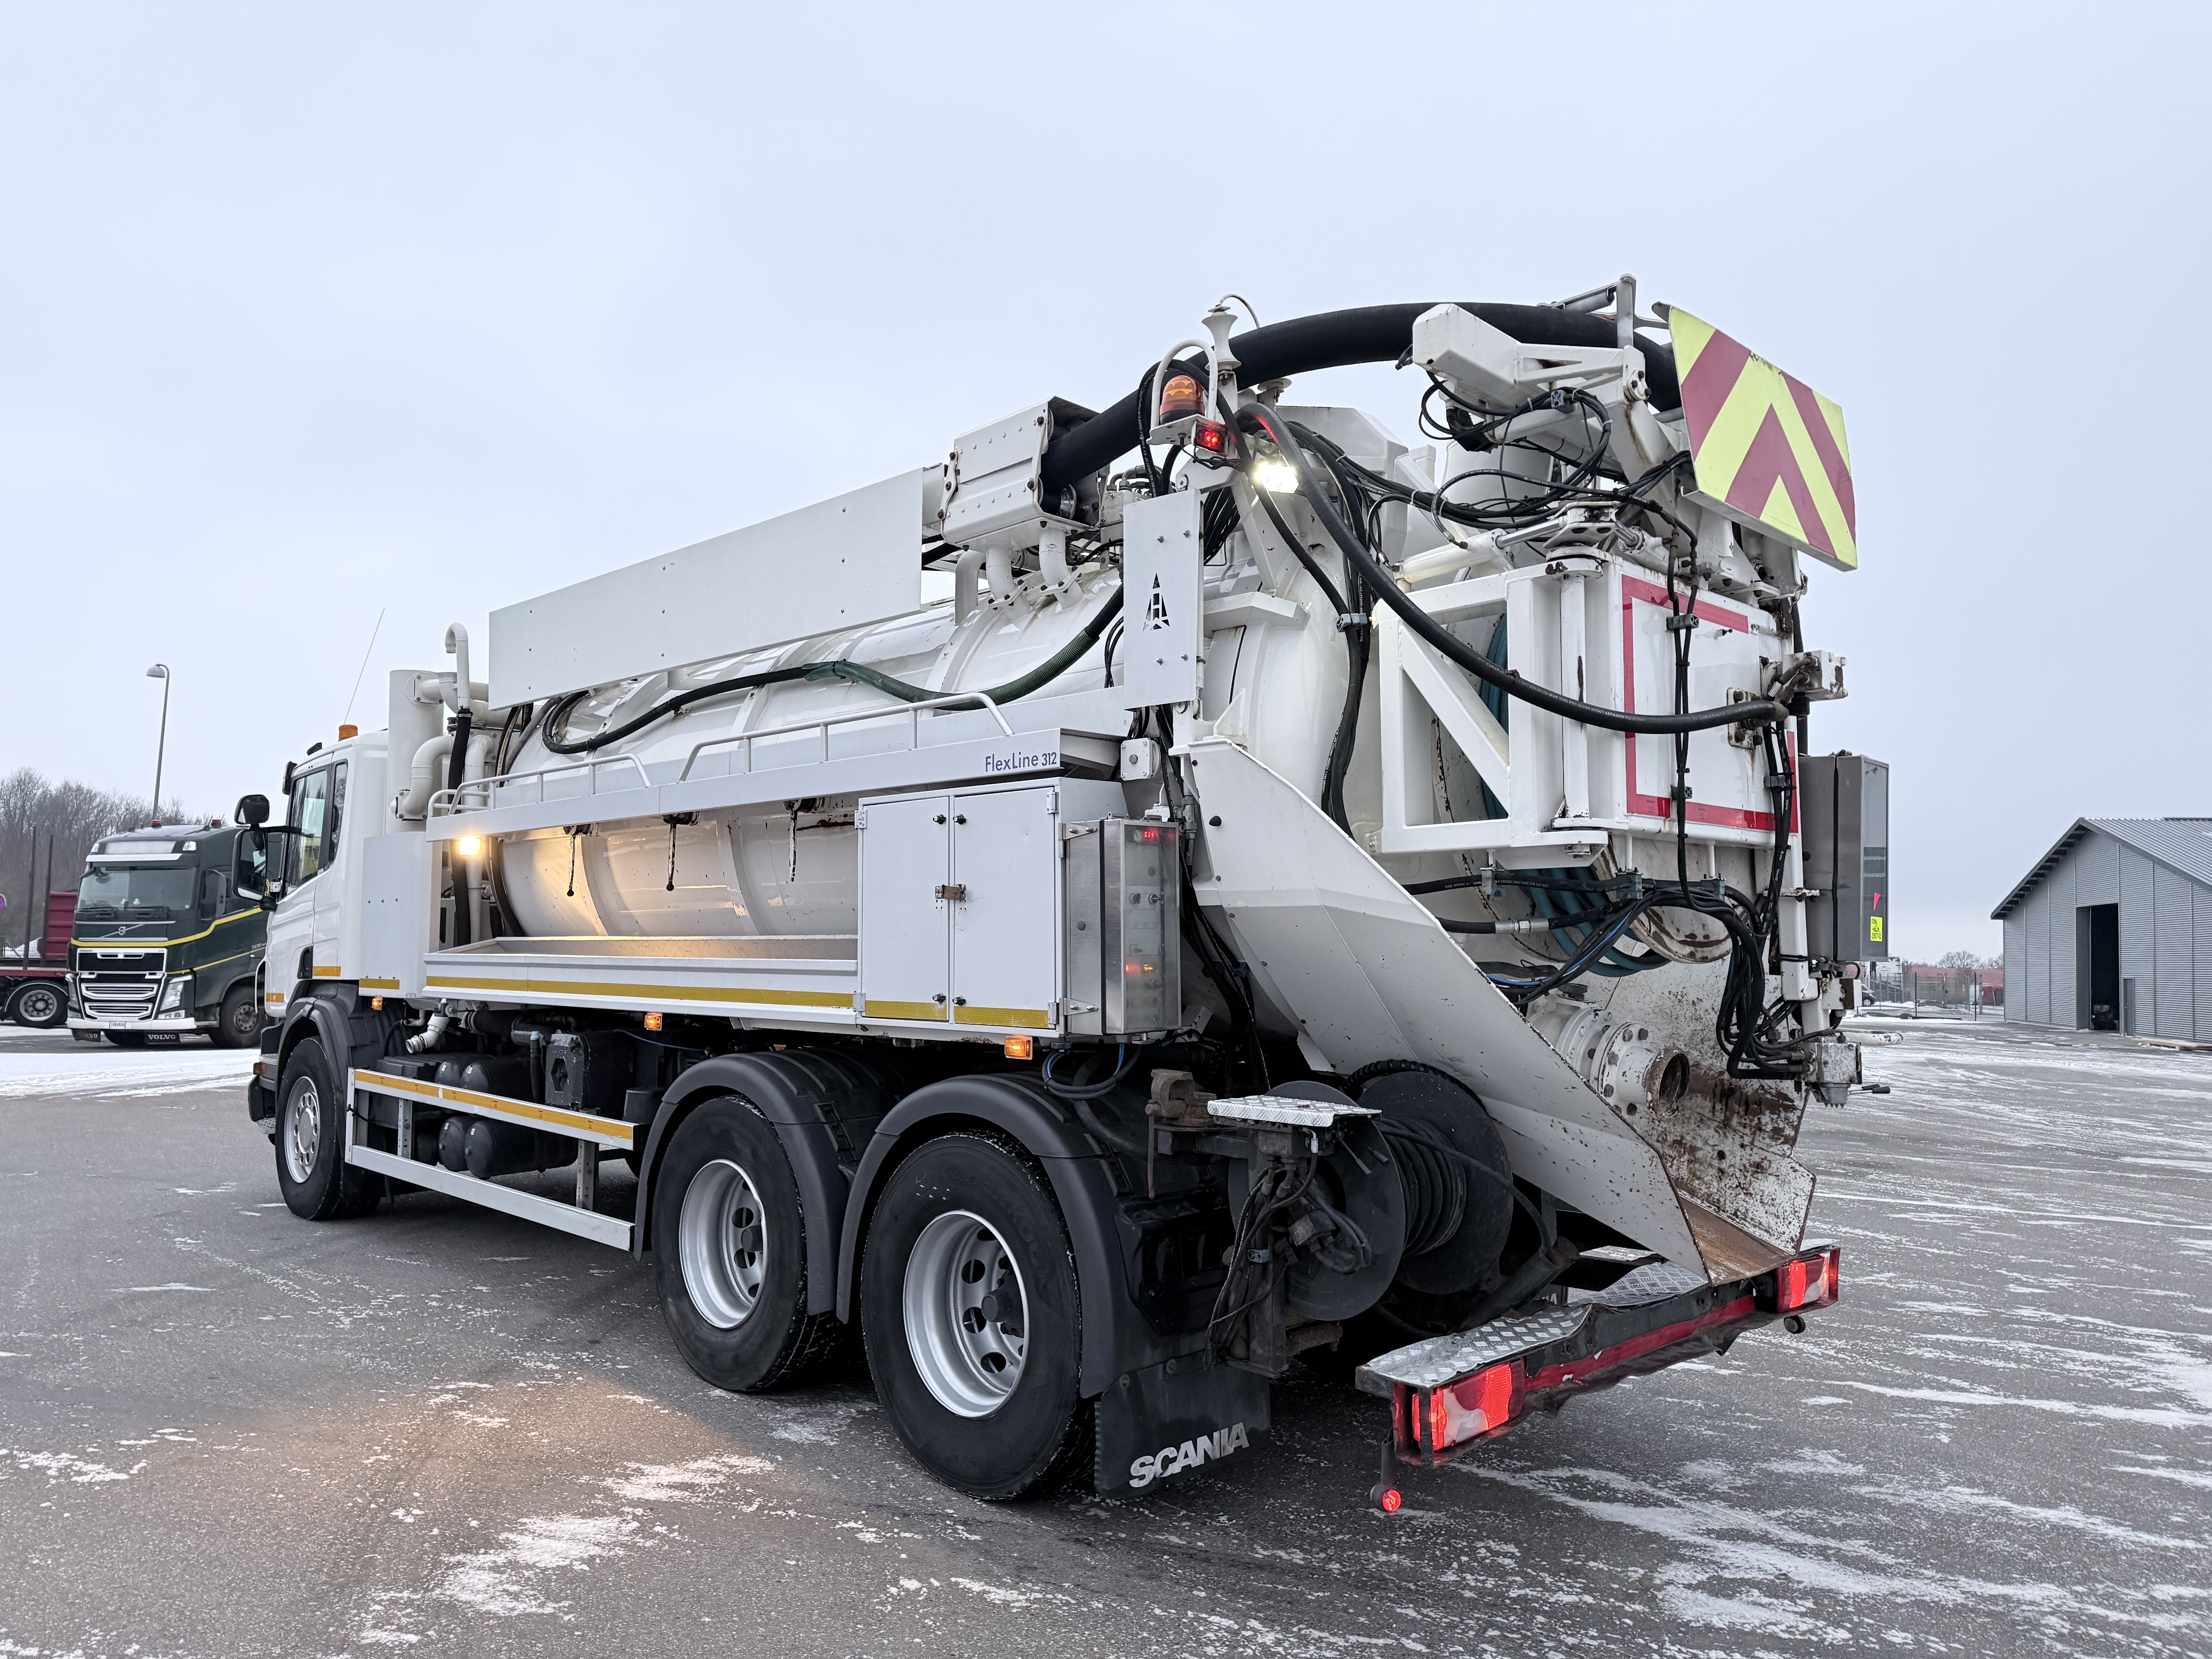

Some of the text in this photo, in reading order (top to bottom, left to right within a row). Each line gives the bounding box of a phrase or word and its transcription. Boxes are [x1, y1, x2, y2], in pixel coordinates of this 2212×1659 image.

[985, 751, 1057, 772] FlexLine 312
[1129, 1422, 1249, 1488] SCANIA
